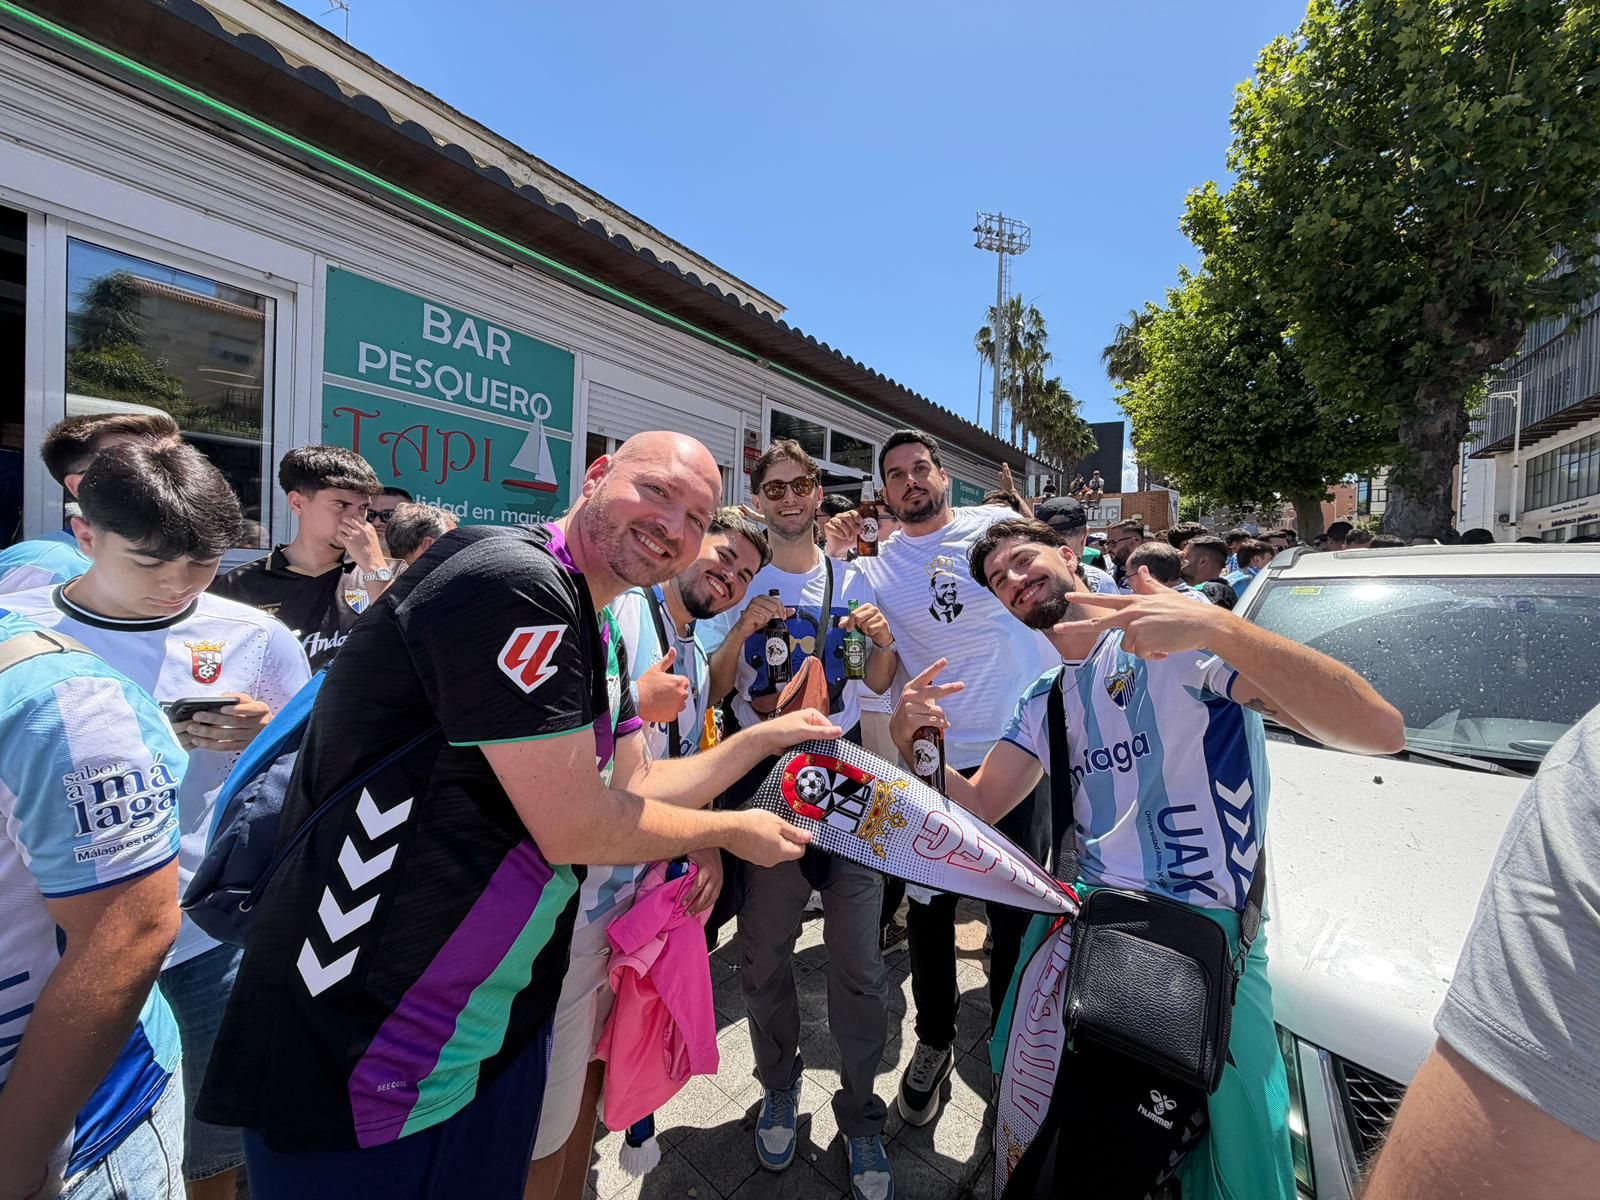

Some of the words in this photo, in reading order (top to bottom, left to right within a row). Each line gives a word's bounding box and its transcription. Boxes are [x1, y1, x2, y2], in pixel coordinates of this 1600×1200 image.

[422, 302, 512, 366] BAR
[357, 341, 552, 420] PESQUERO
[332, 406, 492, 485] TAPI
[472, 506, 495, 520] en
[63, 762, 124, 784] sabor
[73, 787, 177, 835] laga
[77, 842, 124, 861] Málaga
[126, 837, 141, 848] es
[1157, 804, 1218, 900] UAX
[376, 1081, 407, 1092] BEECOOL
[1137, 1103, 1174, 1130] hummel
